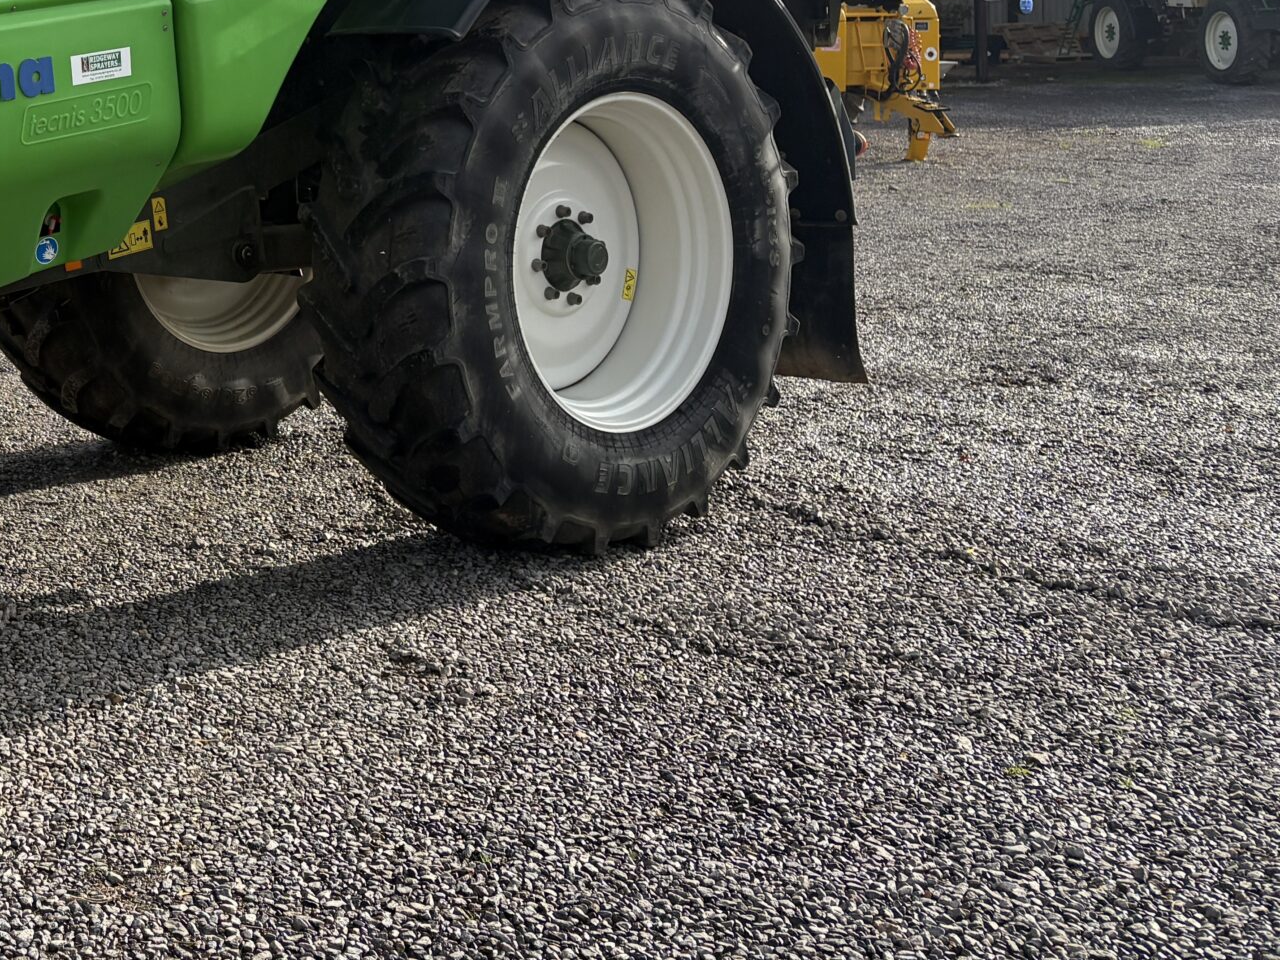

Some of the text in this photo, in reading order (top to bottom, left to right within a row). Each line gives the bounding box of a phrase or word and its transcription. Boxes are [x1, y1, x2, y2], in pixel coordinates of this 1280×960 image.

[89, 52, 120, 62] RIDGEWAY
[89, 60, 119, 71] SPRAYERS
[530, 30, 681, 134] ALLIANCE
[30, 89, 143, 137] tecnis 3500
[483, 221, 523, 402] FARMPRO
[593, 383, 739, 497] ALLIANCE
